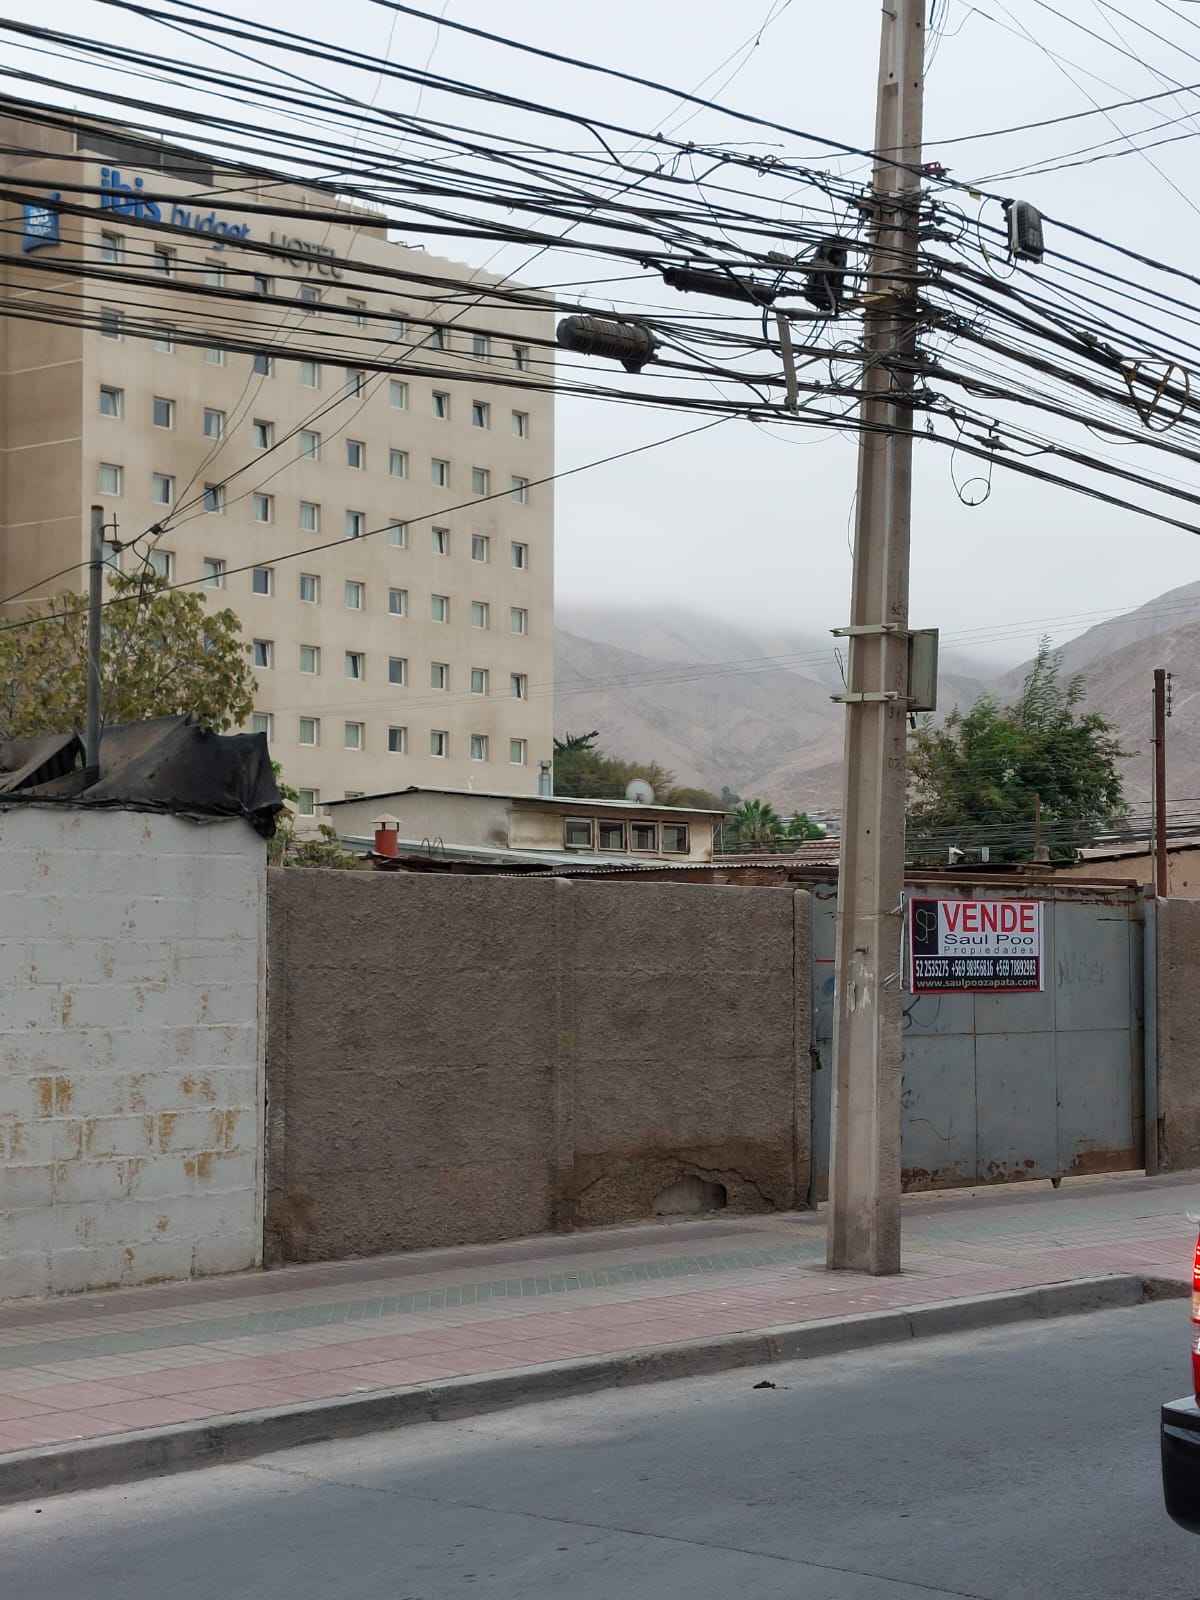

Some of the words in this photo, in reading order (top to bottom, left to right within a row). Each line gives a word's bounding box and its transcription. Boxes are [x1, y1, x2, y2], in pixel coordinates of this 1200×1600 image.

[101, 167, 161, 224] ibis
[943, 904, 1034, 932] VENDE
[944, 933, 988, 945] Saul
[996, 934, 1034, 945] Poo
[944, 946, 1033, 955] Propiedades
[915, 960, 924, 977] 52
[924, 960, 949, 977] 2535275
[951, 960, 965, 977] +569
[995, 960, 1010, 976] +569
[917, 978, 1037, 988] www.saulpoozapata.com
